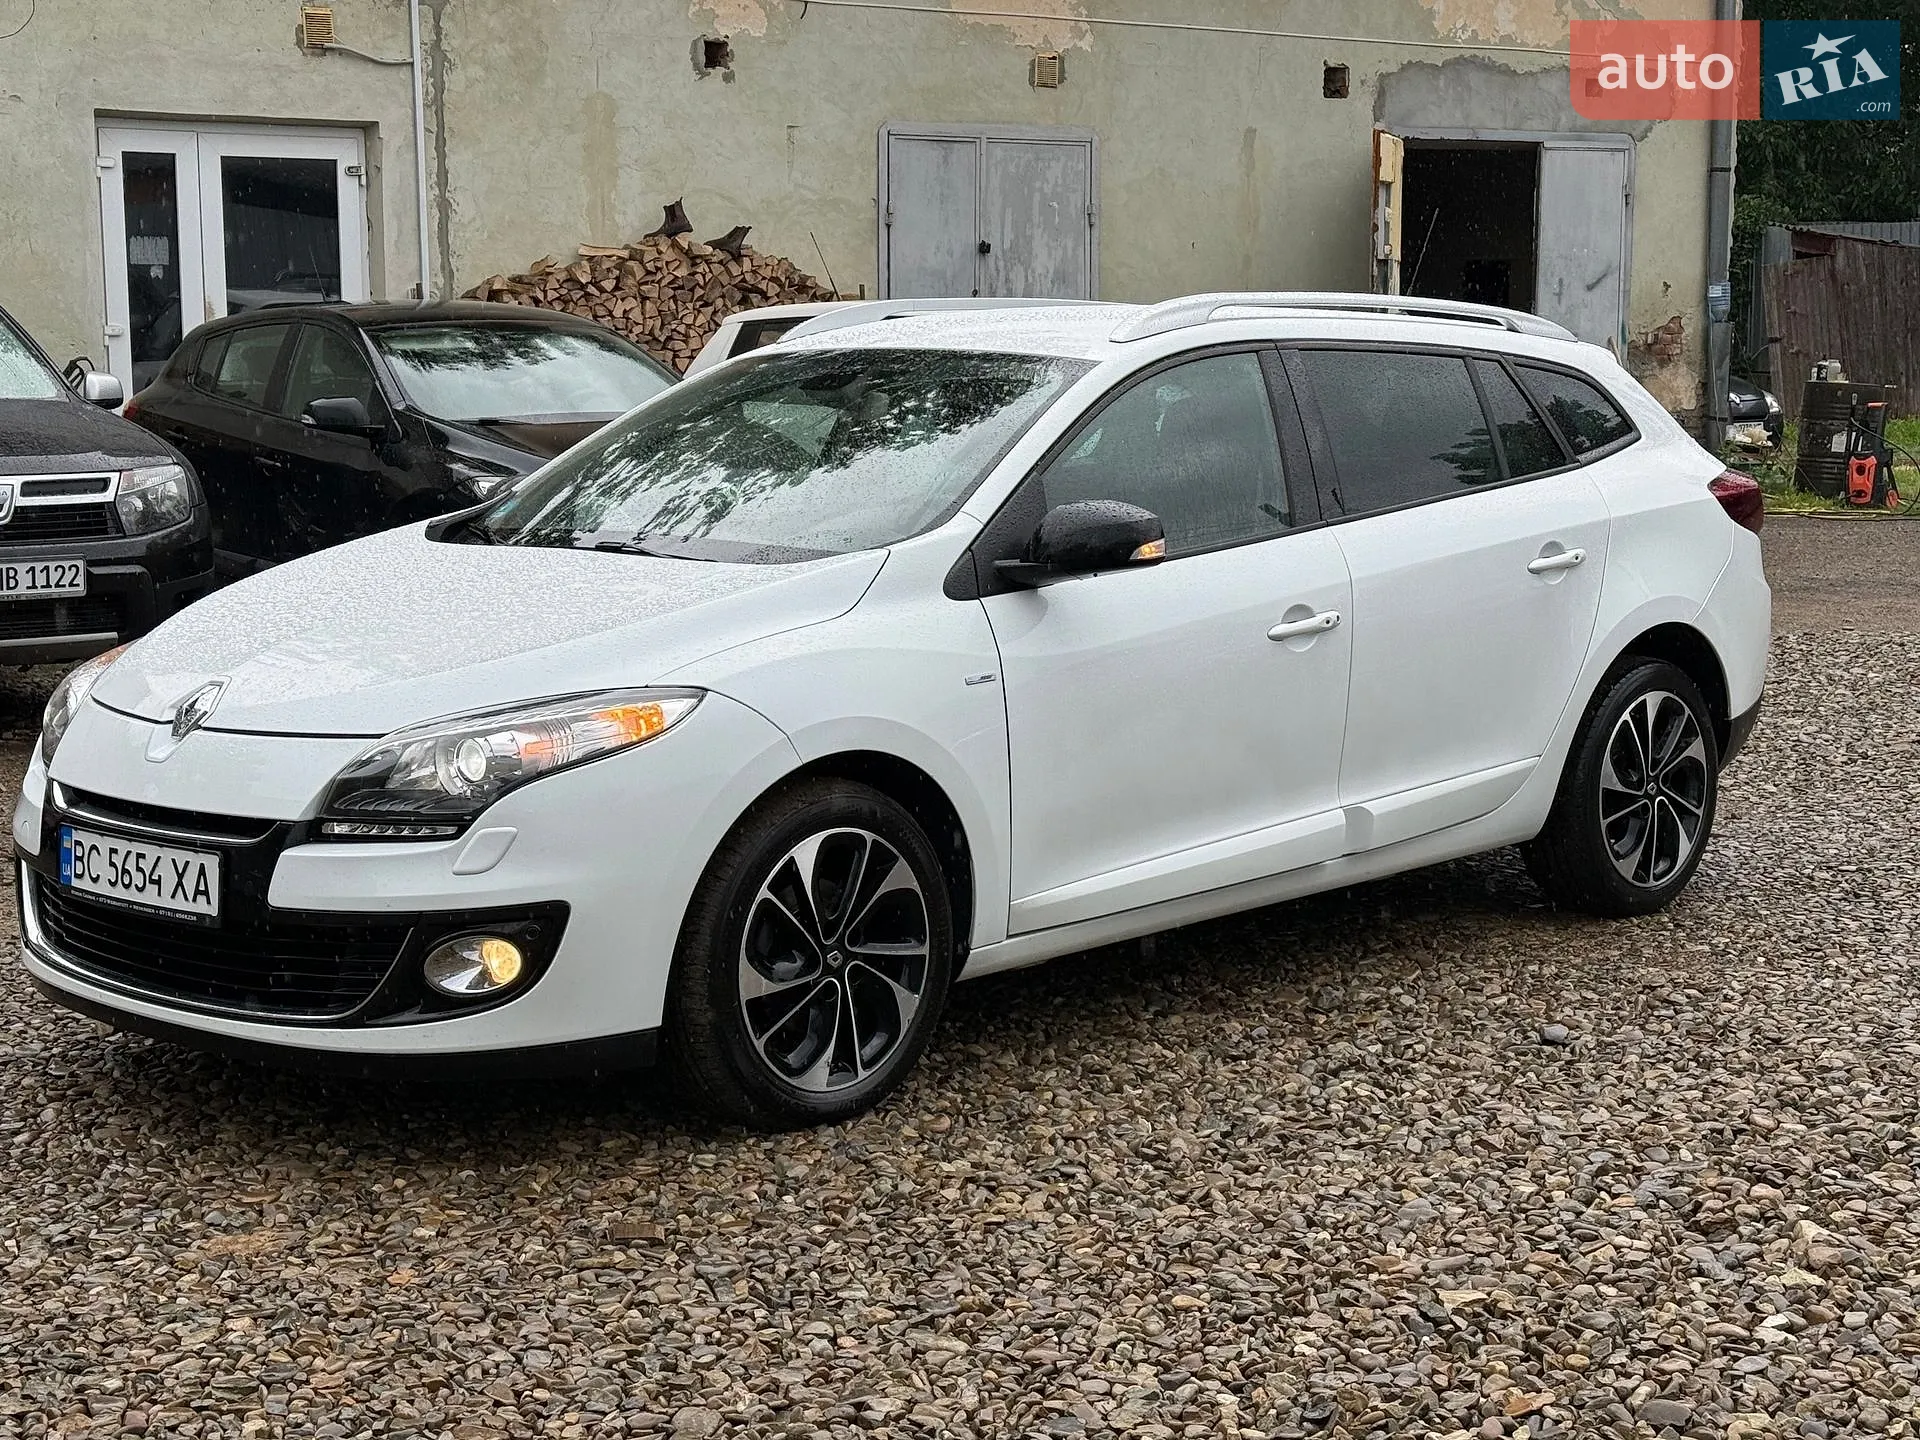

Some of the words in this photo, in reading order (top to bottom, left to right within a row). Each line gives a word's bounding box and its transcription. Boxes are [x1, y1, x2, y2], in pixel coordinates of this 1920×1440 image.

[25, 563, 81, 590] 1122
[73, 839, 101, 884] BC
[107, 847, 162, 897] 5654
[170, 857, 212, 905] XA
